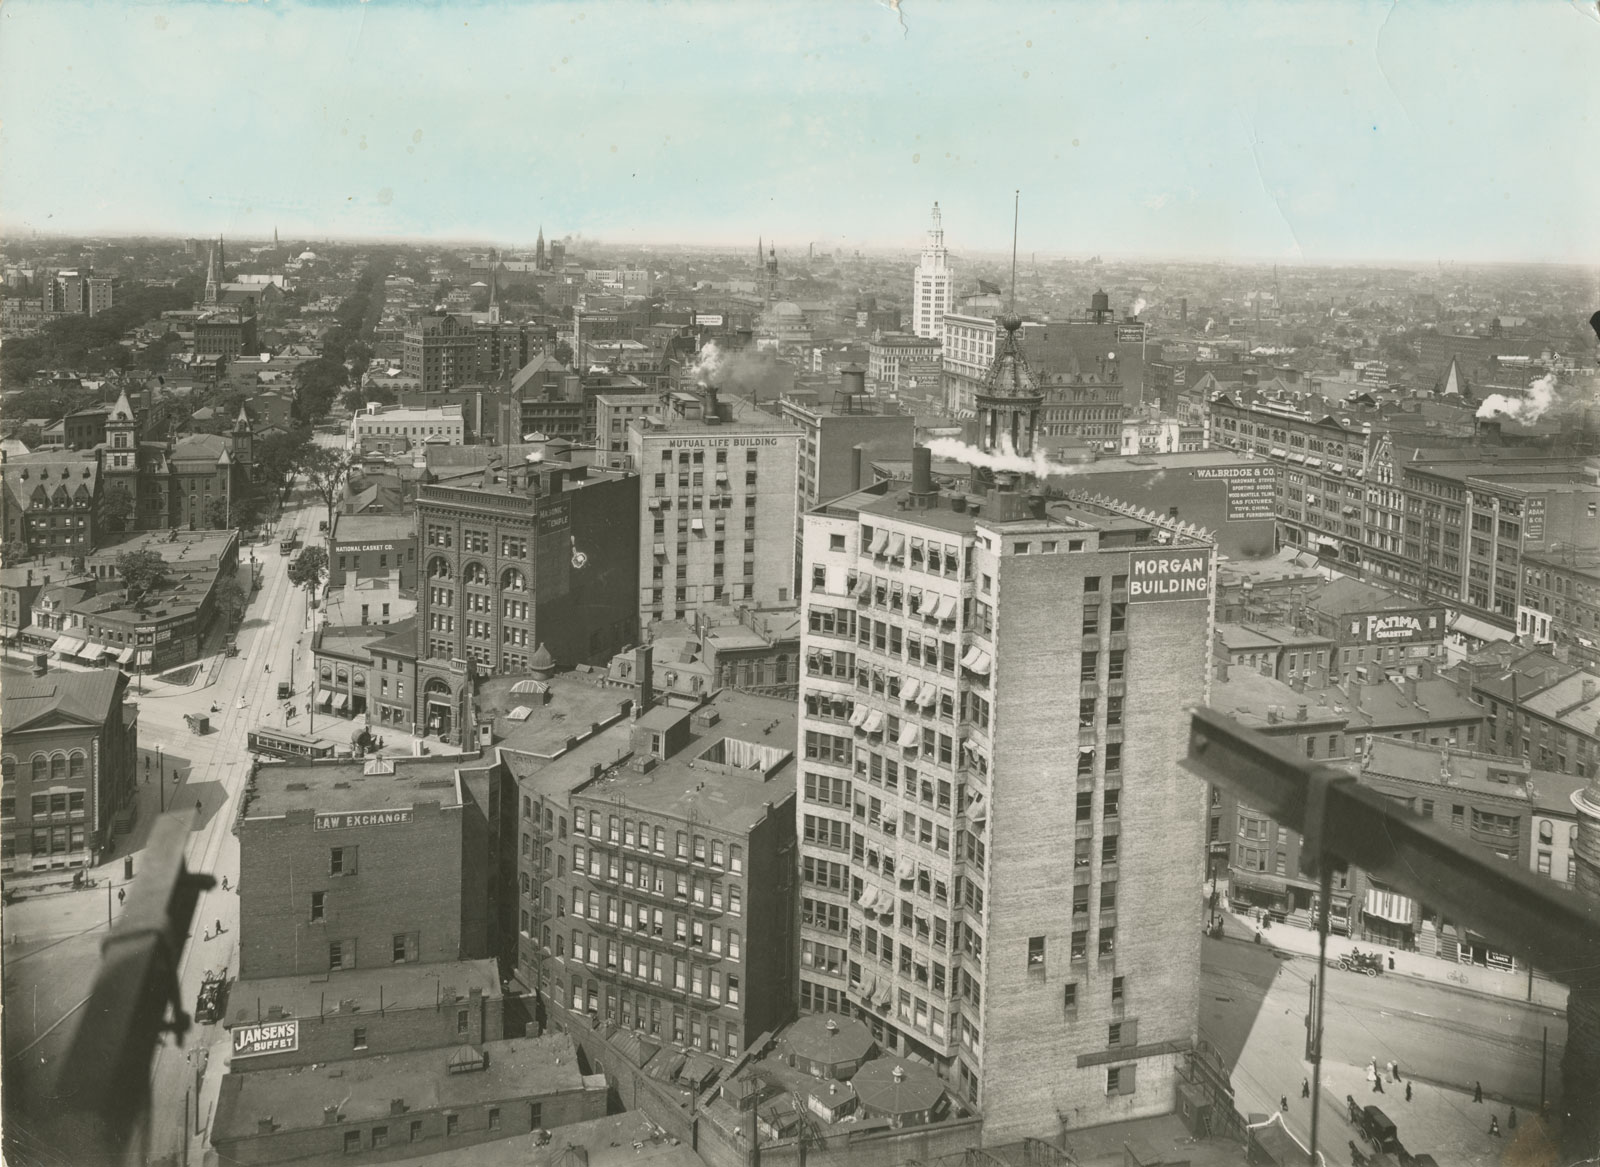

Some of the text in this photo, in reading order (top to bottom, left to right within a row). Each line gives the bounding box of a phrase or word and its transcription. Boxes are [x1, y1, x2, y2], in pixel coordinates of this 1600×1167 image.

[669, 438, 777, 448] MUTUAL LIFE BUILDING
[1197, 468, 1275, 478] WALBRIDGE & CO.
[1134, 557, 1203, 575] MORGAN
[1130, 577, 1207, 595] BUILDING
[1367, 616, 1422, 640] FATIMA
[316, 816, 340, 829] LAW
[234, 1023, 295, 1051] JANSEN'S
[253, 1038, 293, 1052] BUFFET
